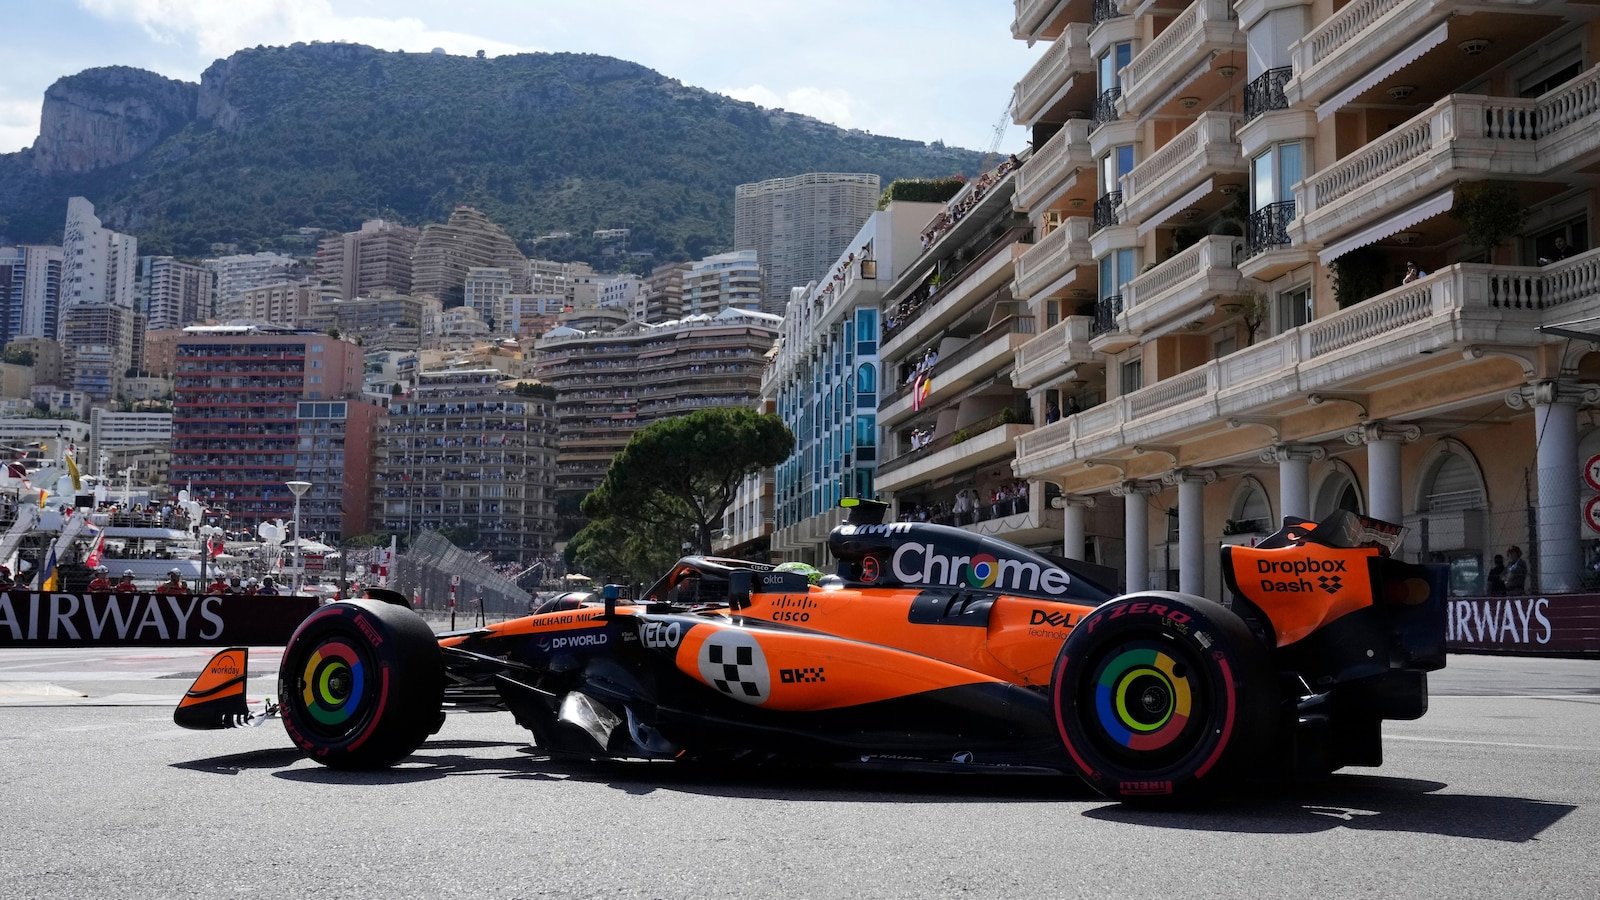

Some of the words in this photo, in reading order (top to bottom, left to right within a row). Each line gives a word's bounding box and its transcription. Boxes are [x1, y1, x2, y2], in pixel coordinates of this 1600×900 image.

[892, 541, 1071, 595] Chrome
[1257, 557, 1347, 576] Dropbox
[763, 574, 784, 584] okta
[1261, 578, 1314, 593] Dash
[533, 616, 573, 627] RICHARD
[772, 612, 809, 622] CISCO
[1087, 614, 1104, 635] P
[1109, 602, 1192, 624] ZERO
[1446, 598, 1552, 645] IRWAYS
[354, 614, 384, 648] PIRELLI
[552, 637, 567, 648] DP
[568, 634, 607, 647] WORLD
[212, 666, 239, 677] workday
[1119, 780, 1173, 795] PIRELLI
